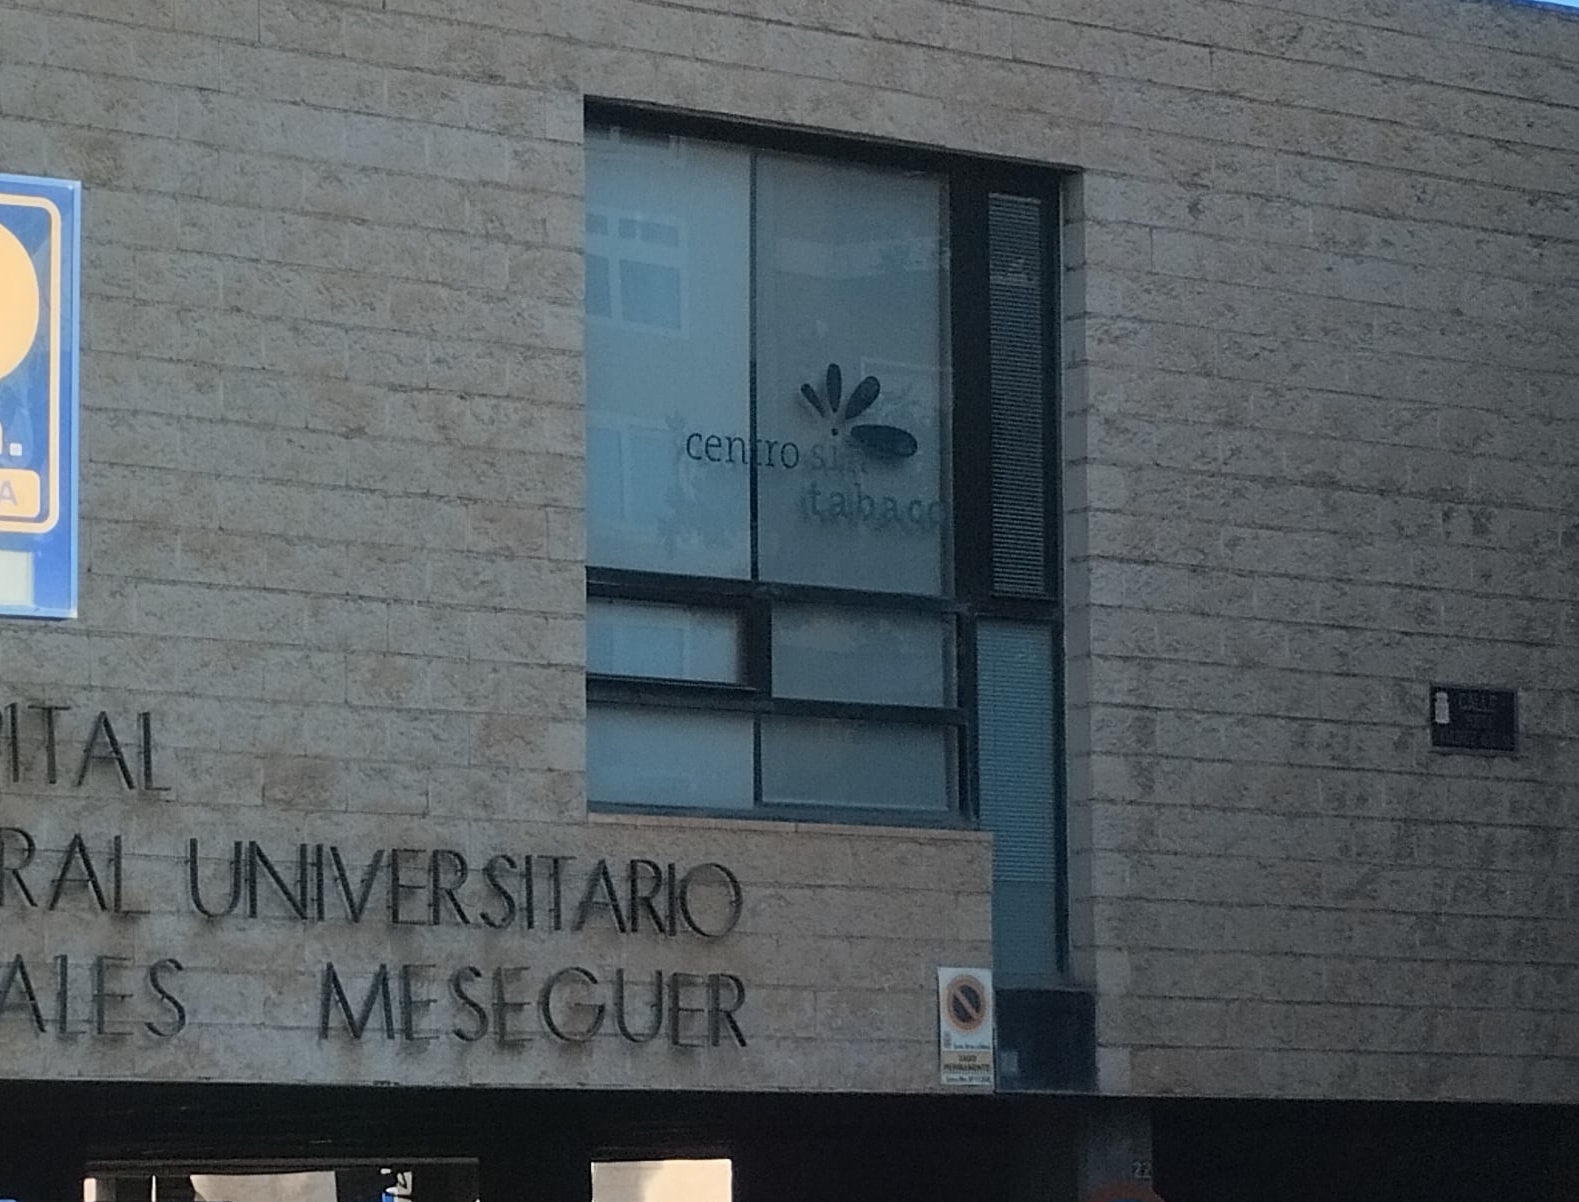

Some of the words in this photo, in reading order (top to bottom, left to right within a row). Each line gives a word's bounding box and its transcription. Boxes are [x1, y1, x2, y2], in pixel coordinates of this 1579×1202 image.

[685, 431, 800, 469] centro
[189, 837, 743, 939] UNIVERSITARIO
[319, 962, 747, 1048] MESEGUER
